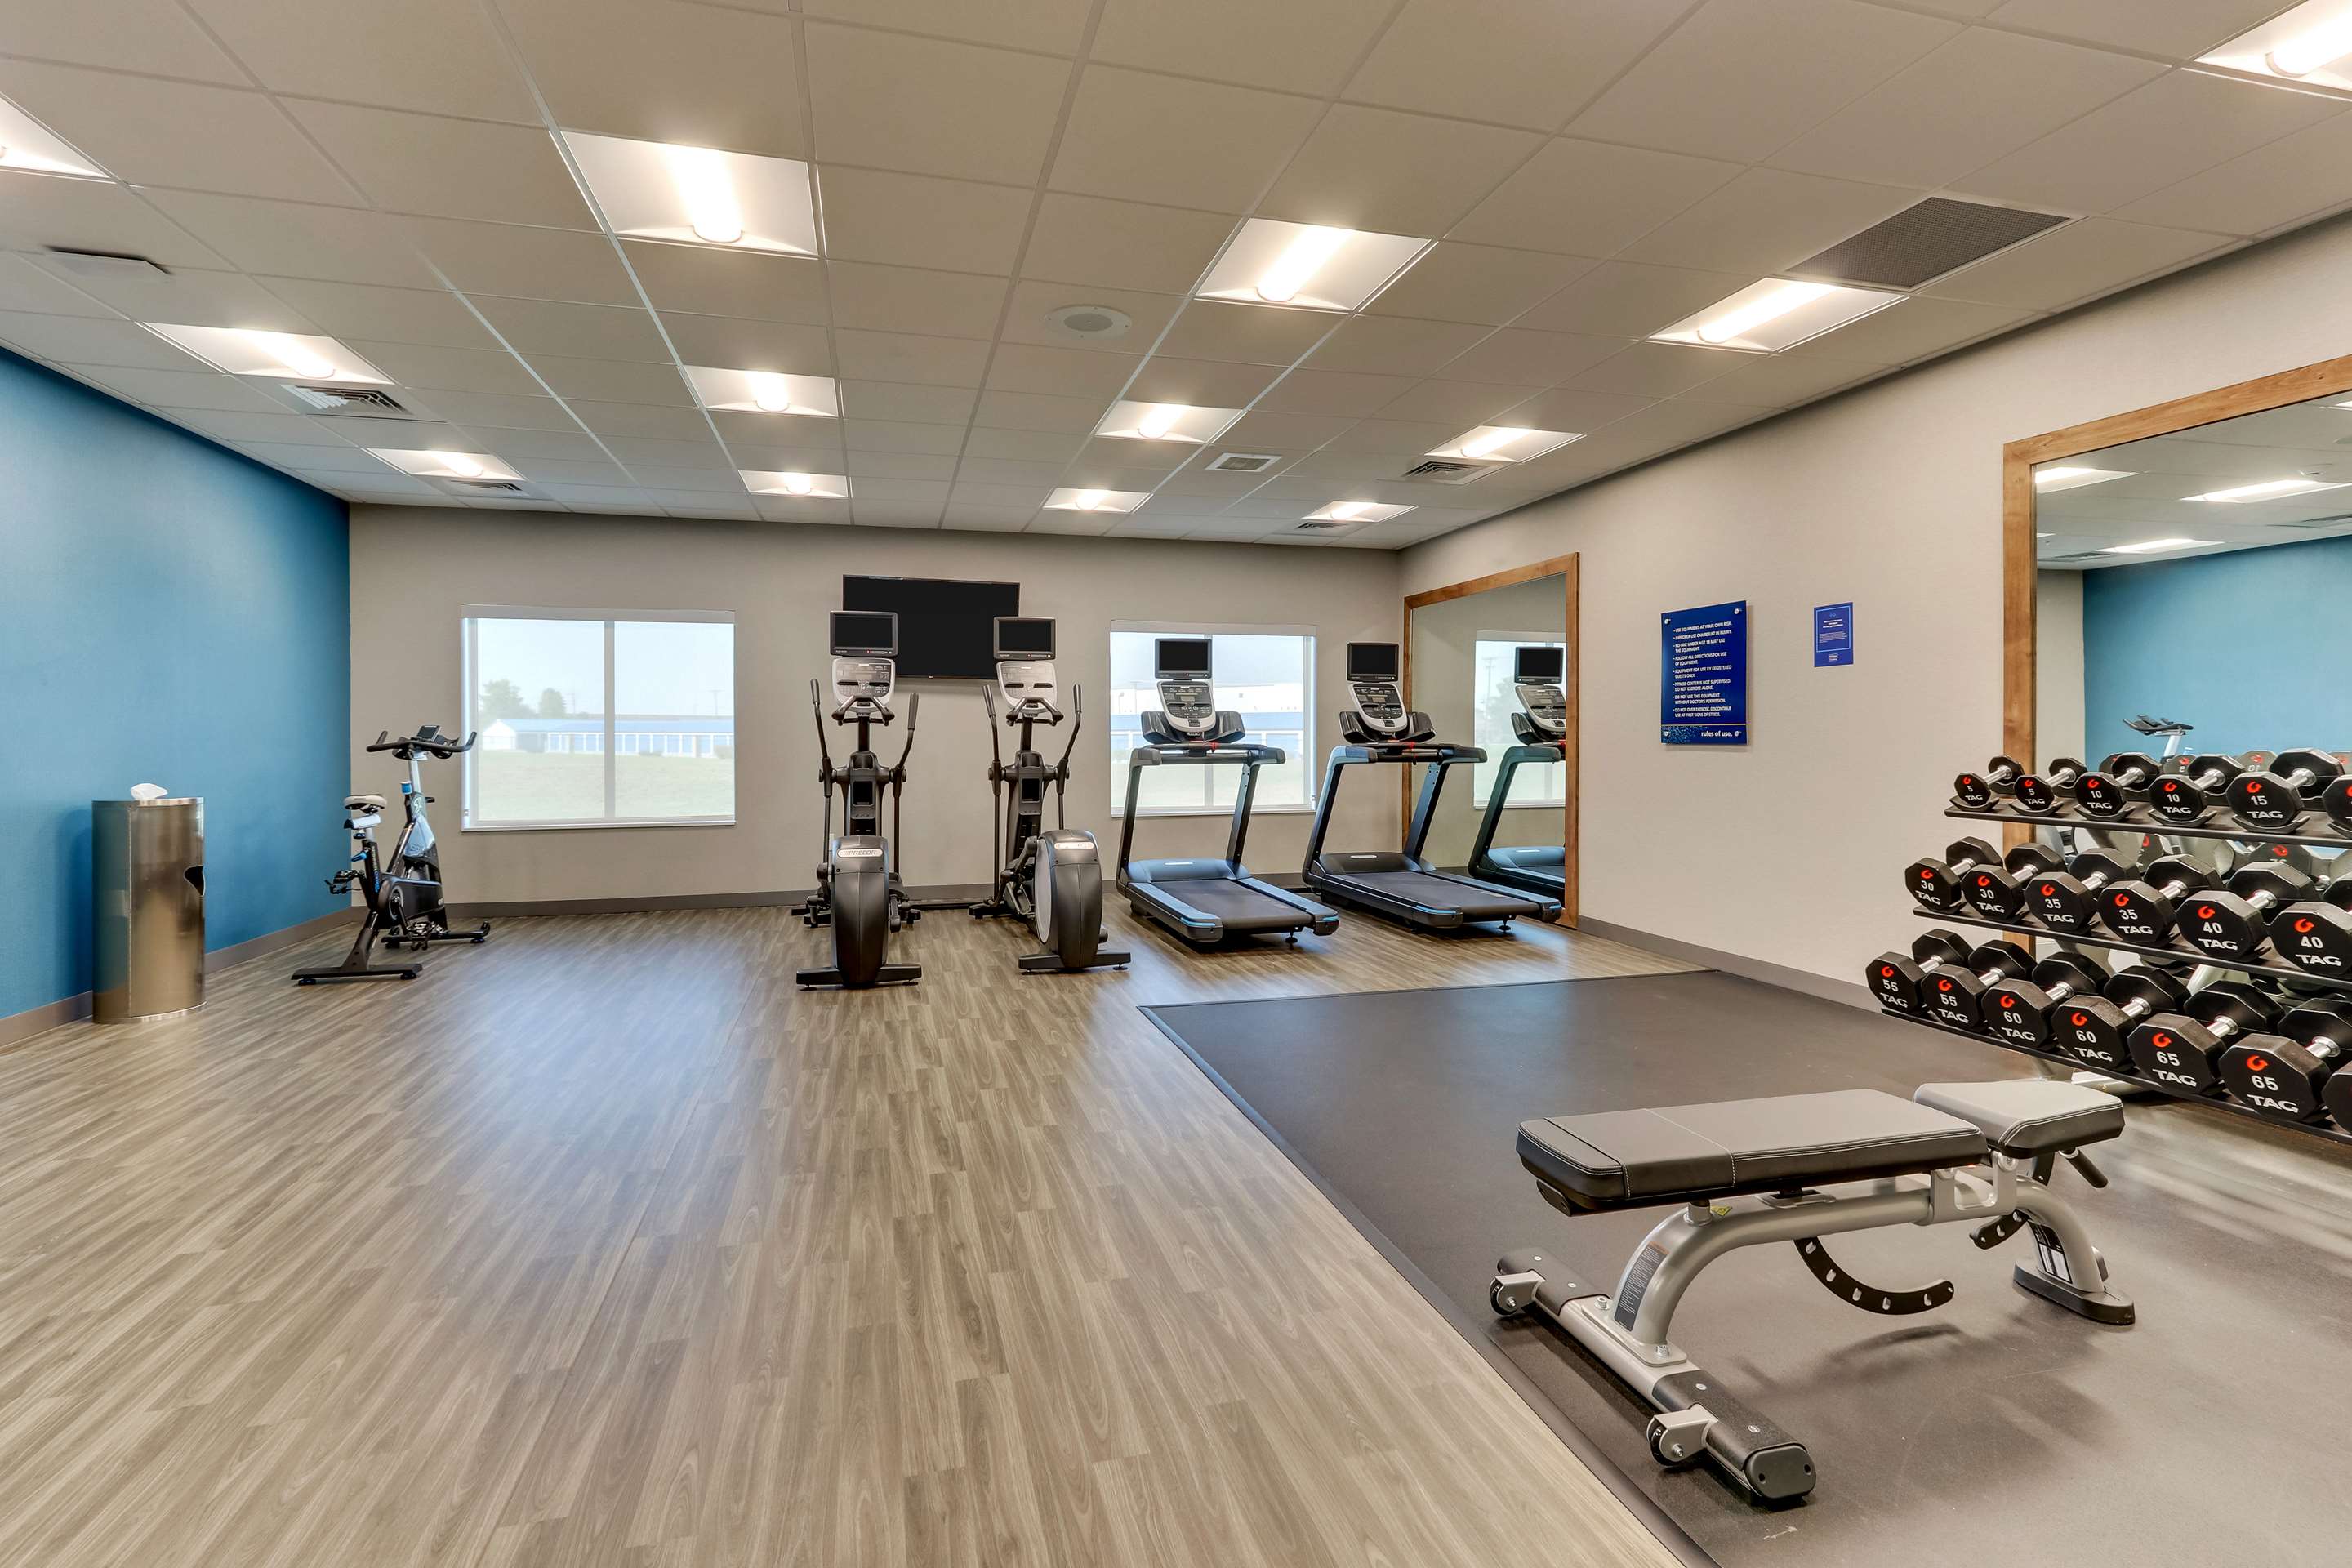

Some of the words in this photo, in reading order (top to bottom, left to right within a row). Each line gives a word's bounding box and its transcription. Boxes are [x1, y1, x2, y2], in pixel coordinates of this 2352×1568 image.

[2167, 794, 2180, 802] 10
[2251, 796, 2267, 806] 15
[2247, 811, 2283, 819] TAG
[1921, 880, 1934, 891] 30
[1916, 891, 1941, 905] TAG
[1980, 889, 1994, 899] 30
[1977, 902, 2004, 913] TAG
[2045, 899, 2062, 909] 35
[2043, 914, 2075, 923] TAG
[2120, 909, 2138, 920] 35
[2119, 925, 2153, 935] TAG
[2203, 922, 2222, 933] 40
[2198, 939, 2238, 950] TAG
[2301, 936, 2323, 948] 40
[2295, 954, 2342, 966] TAG
[1883, 980, 1899, 992] 55
[1880, 993, 1908, 1008] TAG
[1941, 994, 1957, 1007] 55
[1938, 1008, 1969, 1023] TAG
[2003, 1011, 2022, 1024] 60
[2001, 1027, 2036, 1041] TAG
[2076, 1030, 2096, 1043] 60
[2075, 1047, 2113, 1061] TAG
[2156, 1051, 2180, 1066] 65
[2152, 1069, 2197, 1087] TAG
[2251, 1075, 2278, 1091] 65
[2247, 1094, 2299, 1114] TAG
